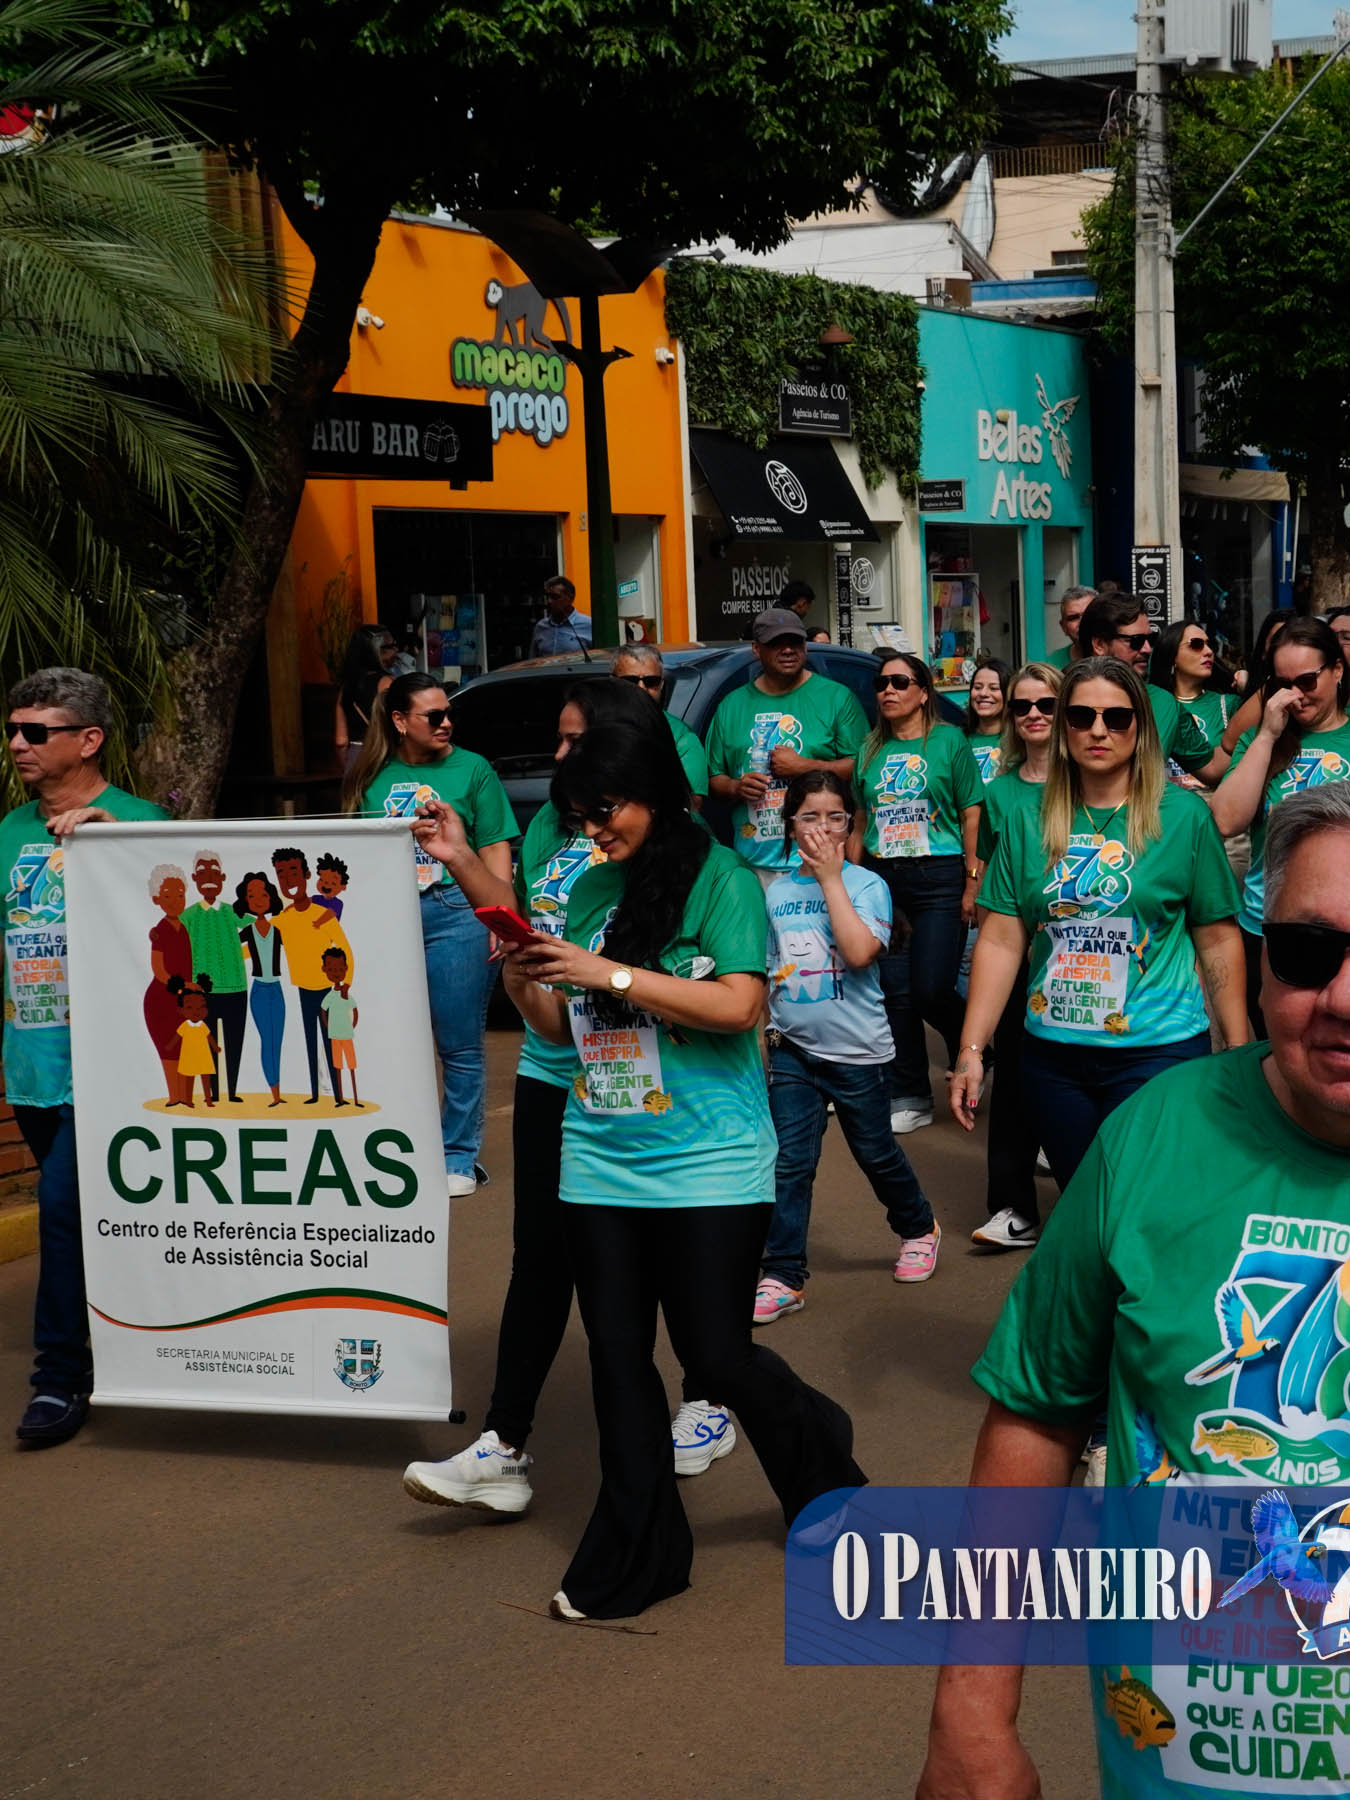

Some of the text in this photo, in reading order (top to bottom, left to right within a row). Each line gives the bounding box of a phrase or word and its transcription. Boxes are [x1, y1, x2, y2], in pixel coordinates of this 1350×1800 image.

[455, 341, 565, 393] macaco
[781, 378, 818, 399] Passeios
[820, 383, 828, 399] &
[489, 391, 569, 444] prego
[819, 410, 840, 421] Turismo
[312, 418, 420, 458] ARU BAR
[977, 409, 1042, 464] Bellas
[990, 469, 1052, 520] Artes
[732, 566, 790, 597] PASSEIOS
[722, 601, 750, 614] COMPRE
[751, 600, 765, 613] SEU
[882, 755, 928, 795] 78
[760, 826, 785, 837] CUID
[15, 848, 66, 910] 78
[1056, 839, 1135, 906] 78
[773, 899, 829, 918] AÚDE BUC
[7, 932, 67, 946] NTUREZA QU
[1051, 926, 1127, 940] NATUREZA QUE
[1068, 939, 1126, 957] ECANTA,
[16, 983, 57, 997] FUTURO
[1050, 978, 1101, 994] FUTURO
[1050, 995, 1067, 1006] QUE
[1074, 994, 1117, 1010] GENTE
[584, 1050, 600, 1062] QUE
[586, 1060, 635, 1076] FUTURO
[609, 1073, 654, 1090] GENTE
[107, 1126, 418, 1208] CREAS
[98, 1219, 436, 1246] Centro de Referência Especializado
[164, 1247, 369, 1269] de Assistência Social
[156, 1347, 296, 1363] SECRETARIA MUNICIPAL DE
[184, 1360, 296, 1376] ASSISTÊNCIA SOCIAL
[1265, 1456, 1342, 1485] ANOS
[1186, 1702, 1244, 1729] QUE
[1252, 1709, 1266, 1732] A
